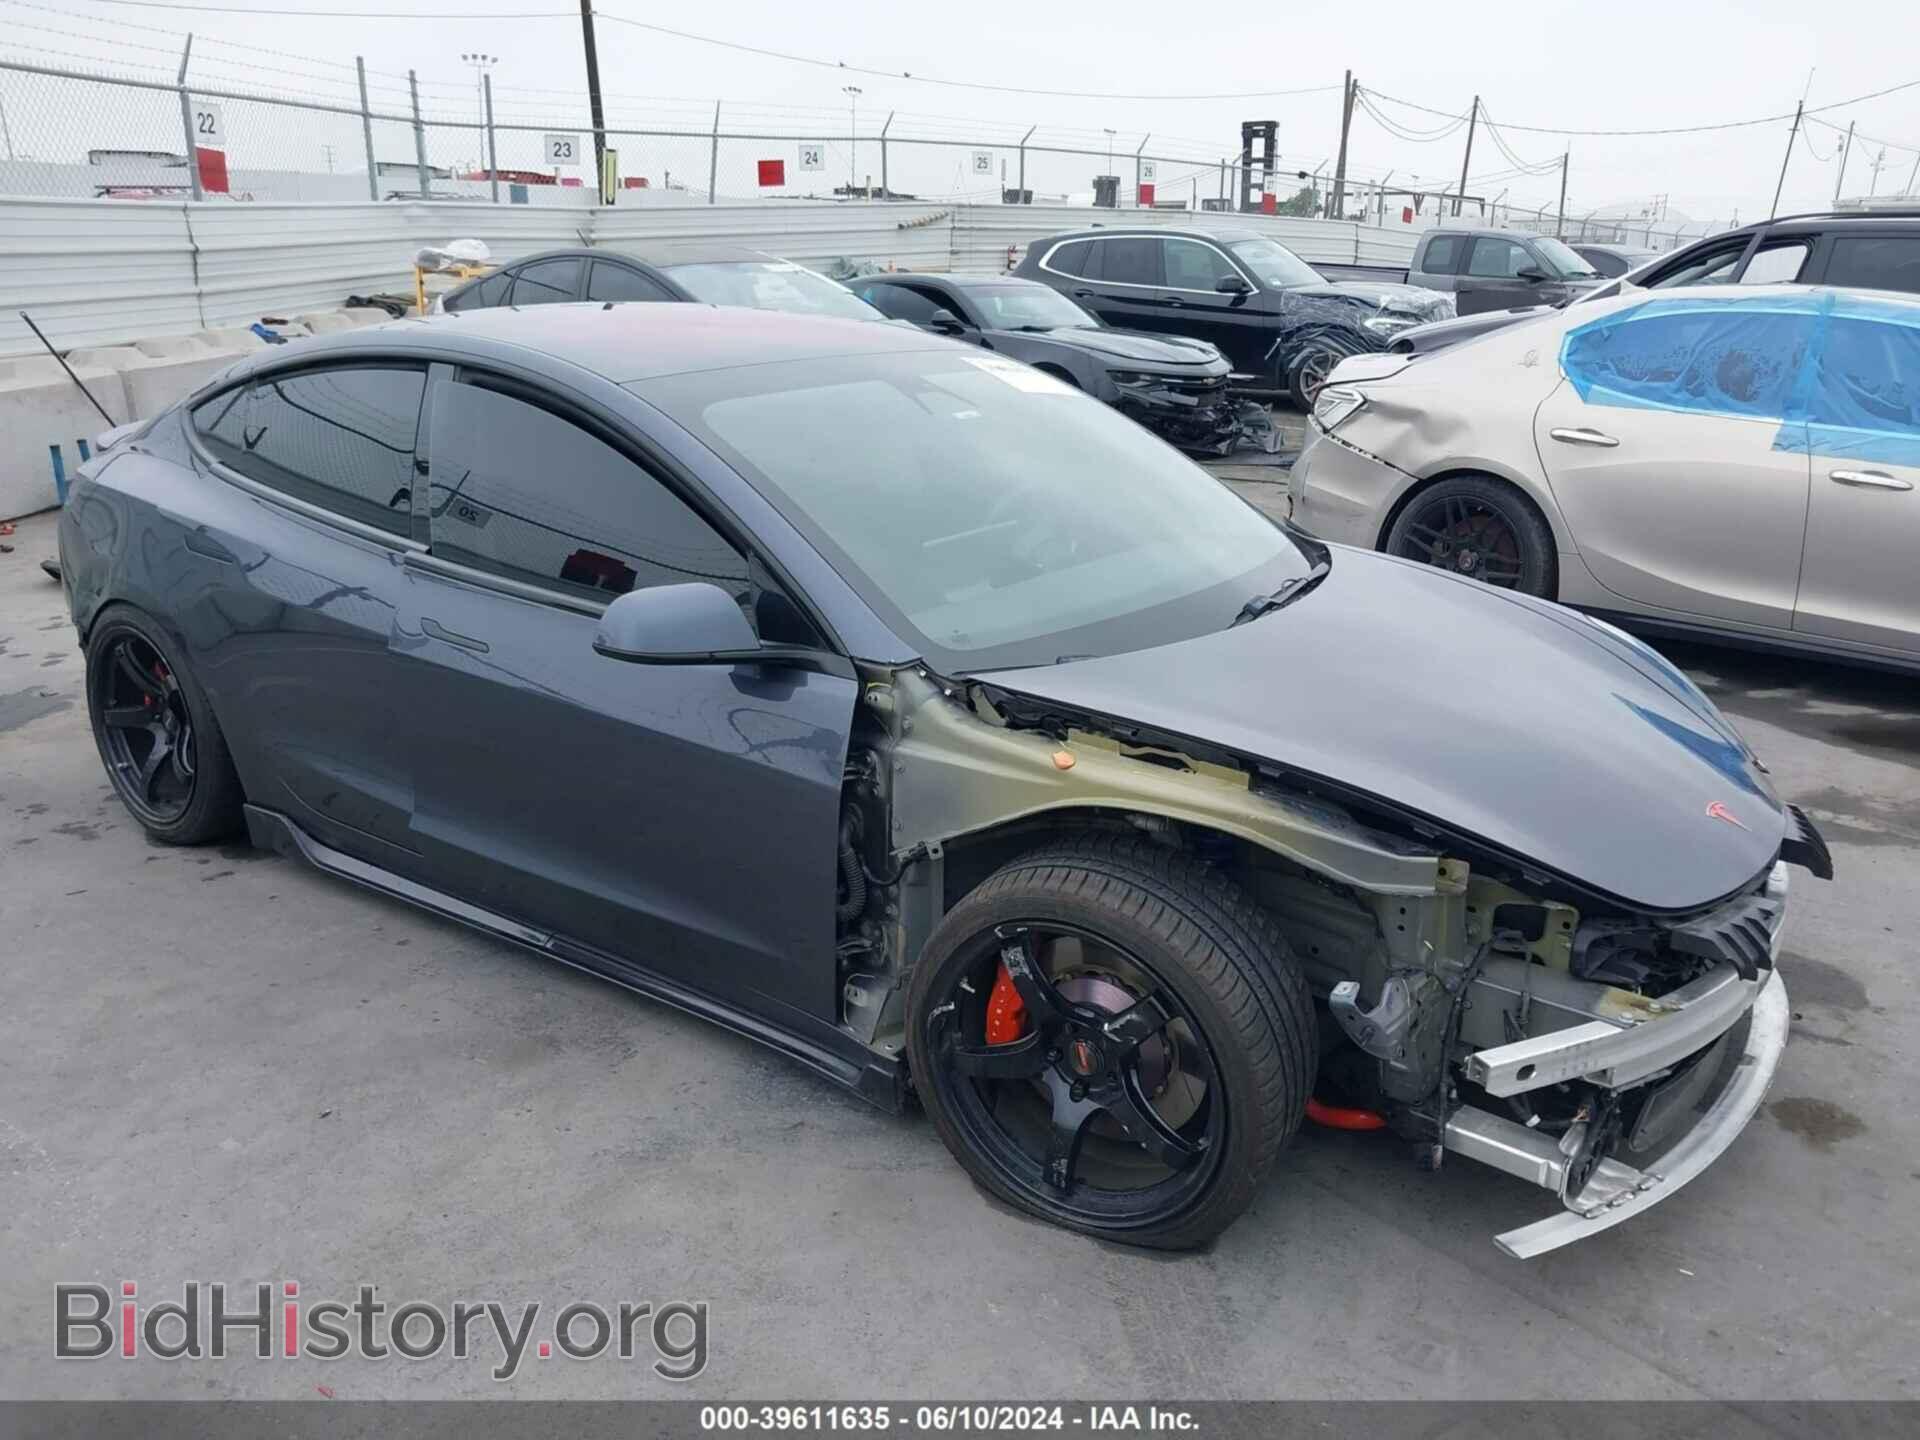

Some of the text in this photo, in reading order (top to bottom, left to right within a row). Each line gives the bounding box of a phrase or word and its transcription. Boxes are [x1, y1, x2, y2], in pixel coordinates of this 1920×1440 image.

[198, 112, 216, 134] 22
[553, 142, 572, 158] 23
[805, 151, 818, 165] 24
[977, 156, 988, 169] 25
